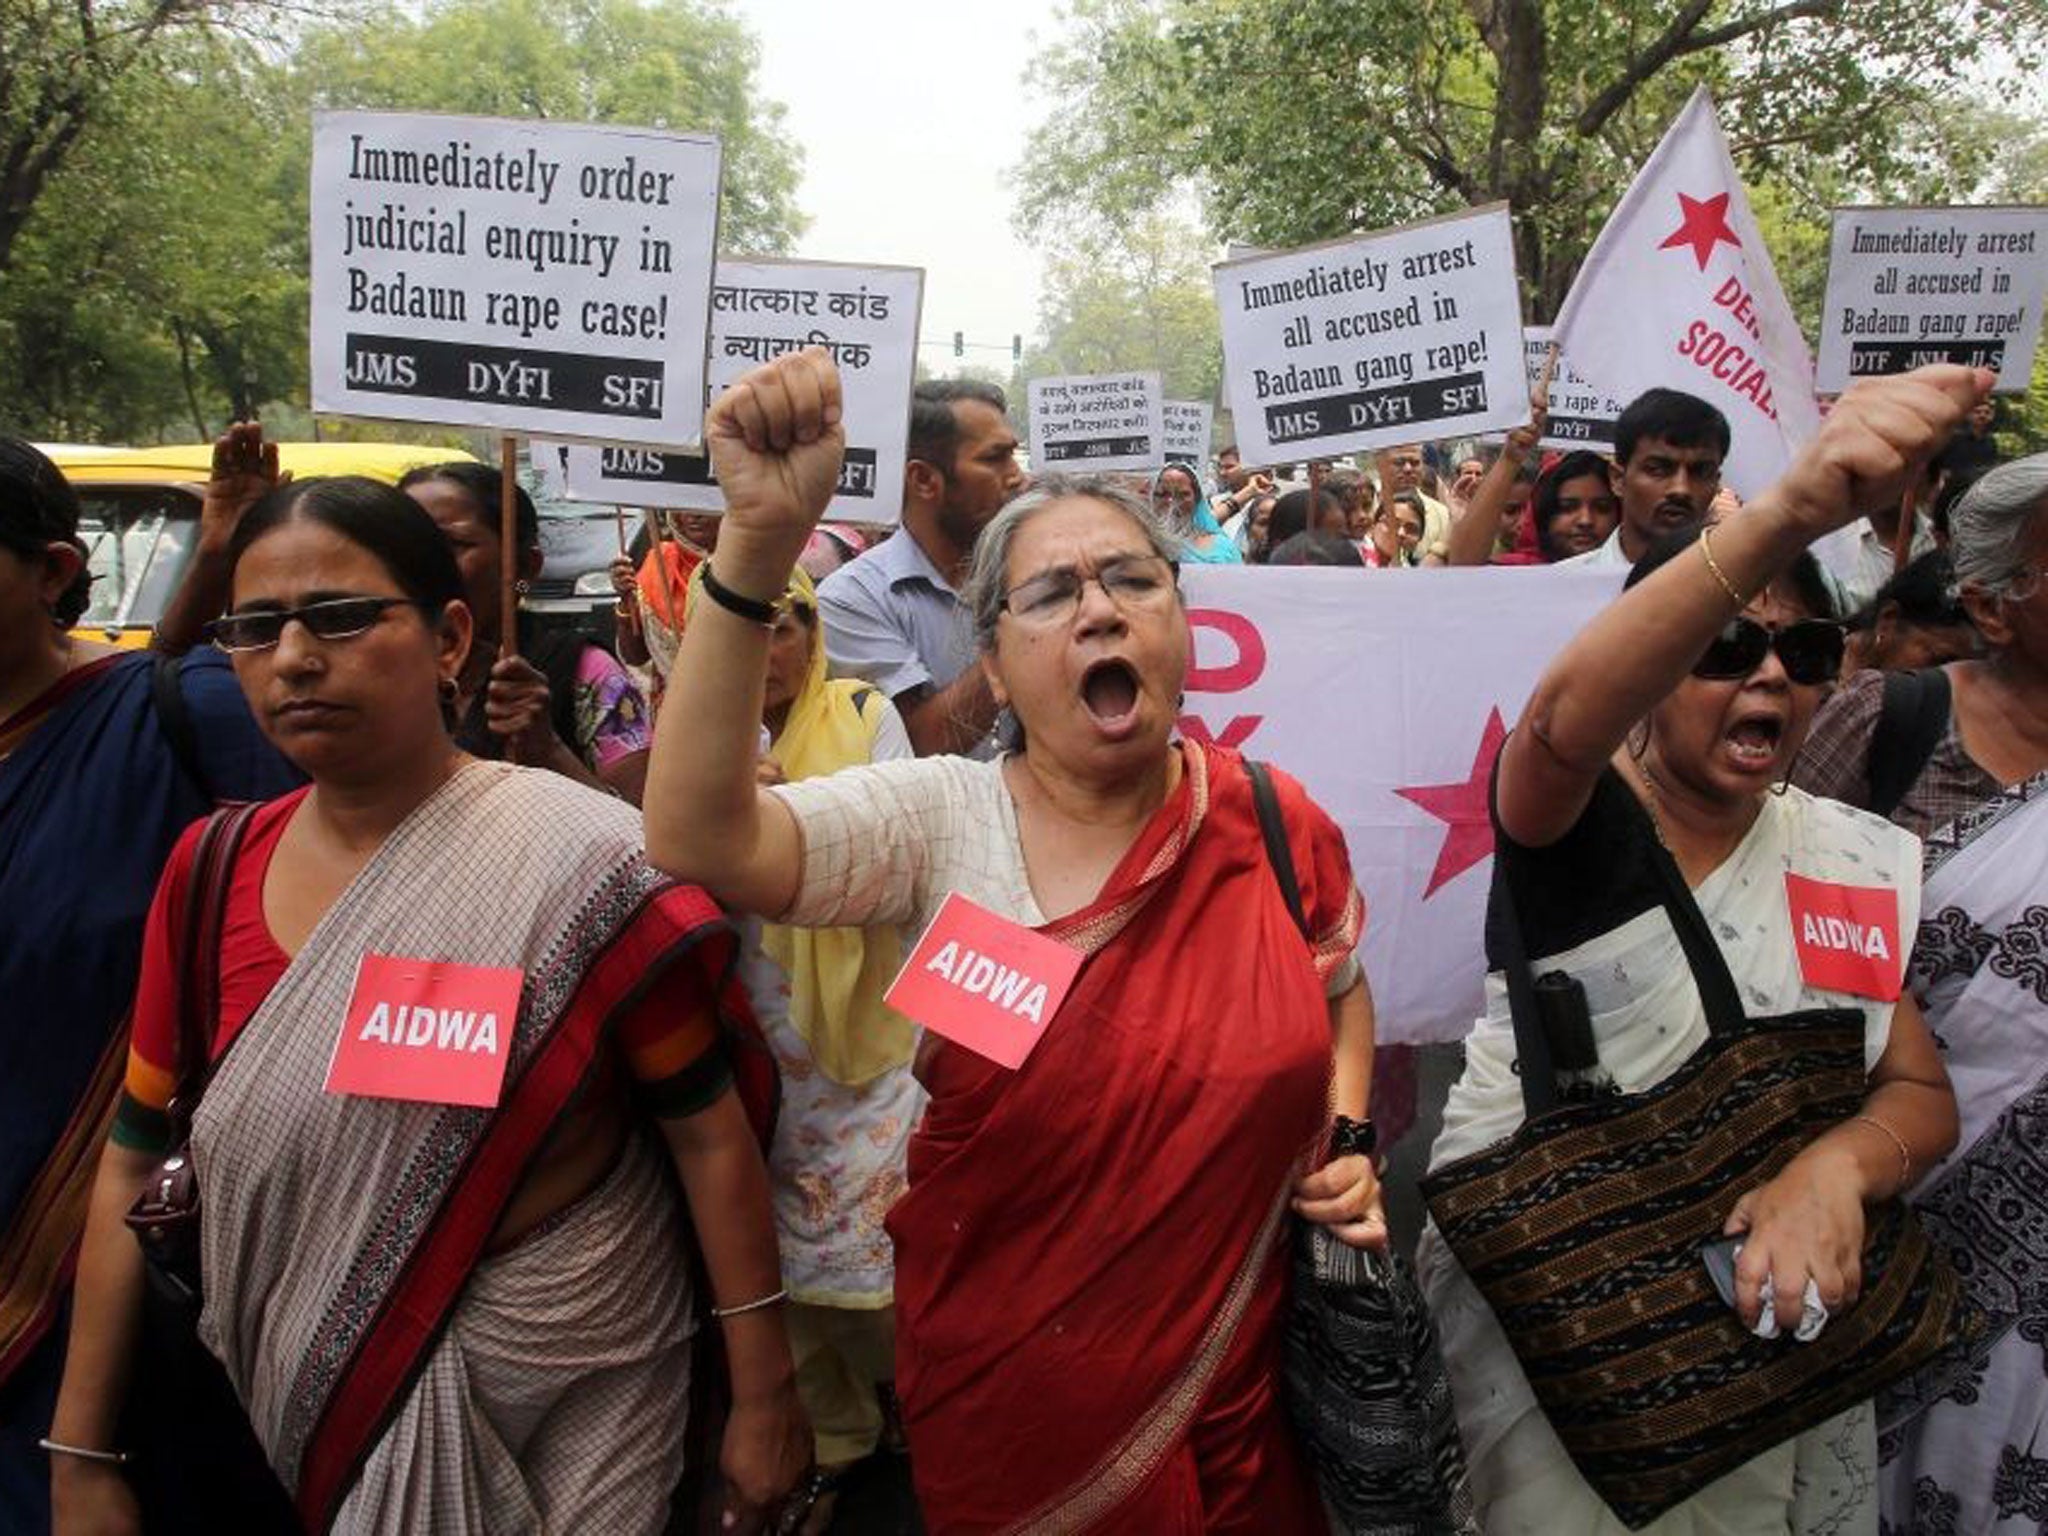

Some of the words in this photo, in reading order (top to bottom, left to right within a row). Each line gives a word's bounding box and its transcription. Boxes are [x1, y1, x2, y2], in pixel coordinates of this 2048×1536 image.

[349, 134, 560, 204] Immediately
[580, 156, 674, 205] order
[344, 200, 466, 255] judicial
[486, 218, 619, 277] enquiry
[640, 225, 671, 272] in
[1851, 226, 1967, 258] Immediately
[1977, 229, 2036, 253] arrest
[348, 267, 466, 321] Badaun
[486, 292, 559, 338] rape
[582, 294, 667, 340] case!
[712, 285, 820, 316] लात्कार
[828, 285, 891, 320] कांड
[1241, 258, 1388, 312] Immediately
[1402, 240, 1476, 280] arrest
[1874, 267, 1898, 295] all
[1905, 266, 1983, 295] accused
[1991, 267, 2011, 293] in
[1283, 316, 1313, 348] all
[1325, 296, 1421, 341] accused
[1433, 291, 1459, 322] in
[1841, 308, 1910, 335] Badaun
[1919, 312, 1967, 340] gang
[1974, 307, 2026, 338] rape!
[347, 351, 417, 388] JMS
[467, 360, 552, 401] DYFI
[602, 374, 662, 411] SFI
[1253, 363, 1343, 399] Badaun
[1355, 352, 1413, 388] gang
[1427, 330, 1488, 373] rape!
[1678, 320, 1778, 421] SOCIAL
[1851, 351, 1892, 372] DTF
[1268, 411, 1321, 439] JMS
[1350, 393, 1414, 427] DYFI
[1442, 380, 1487, 412] SFI
[1552, 421, 1591, 438] DYFI
[1565, 395, 1599, 414] rape
[602, 448, 665, 475] JMS
[1802, 911, 1891, 961] AIDWA
[926, 940, 1049, 1025] AIDWA
[358, 1001, 499, 1056] AIDWA
